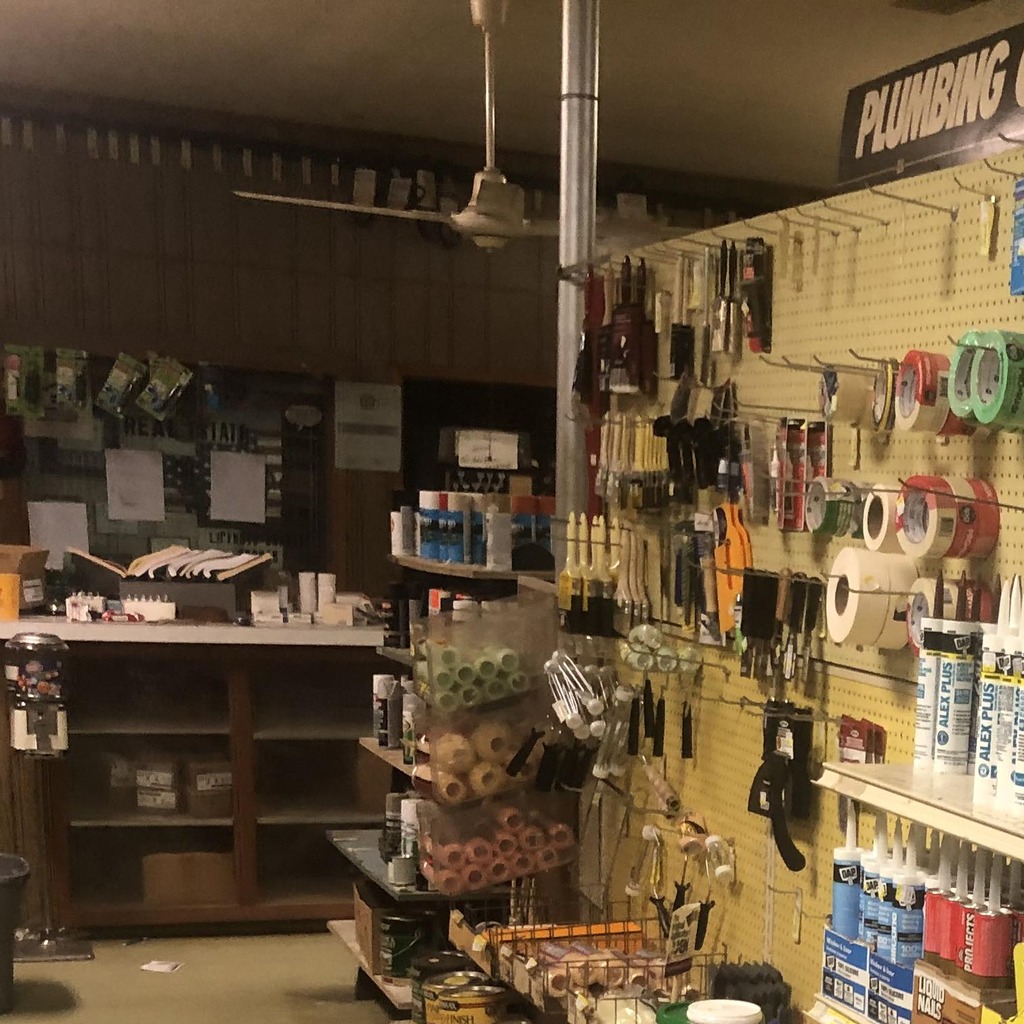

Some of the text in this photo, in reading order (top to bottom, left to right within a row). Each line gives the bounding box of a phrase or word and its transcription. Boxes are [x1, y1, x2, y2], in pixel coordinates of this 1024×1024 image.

[855, 39, 1011, 159] PLUMBING
[956, 636, 970, 649] DAP
[939, 661, 953, 728] ALEX PLUS
[979, 683, 995, 762] ALEX PLUS
[841, 867, 856, 879] DAP
[964, 912, 976, 973] PROJECTS
[917, 994, 942, 1021] NAILS
[919, 976, 946, 1004] LIQUID
